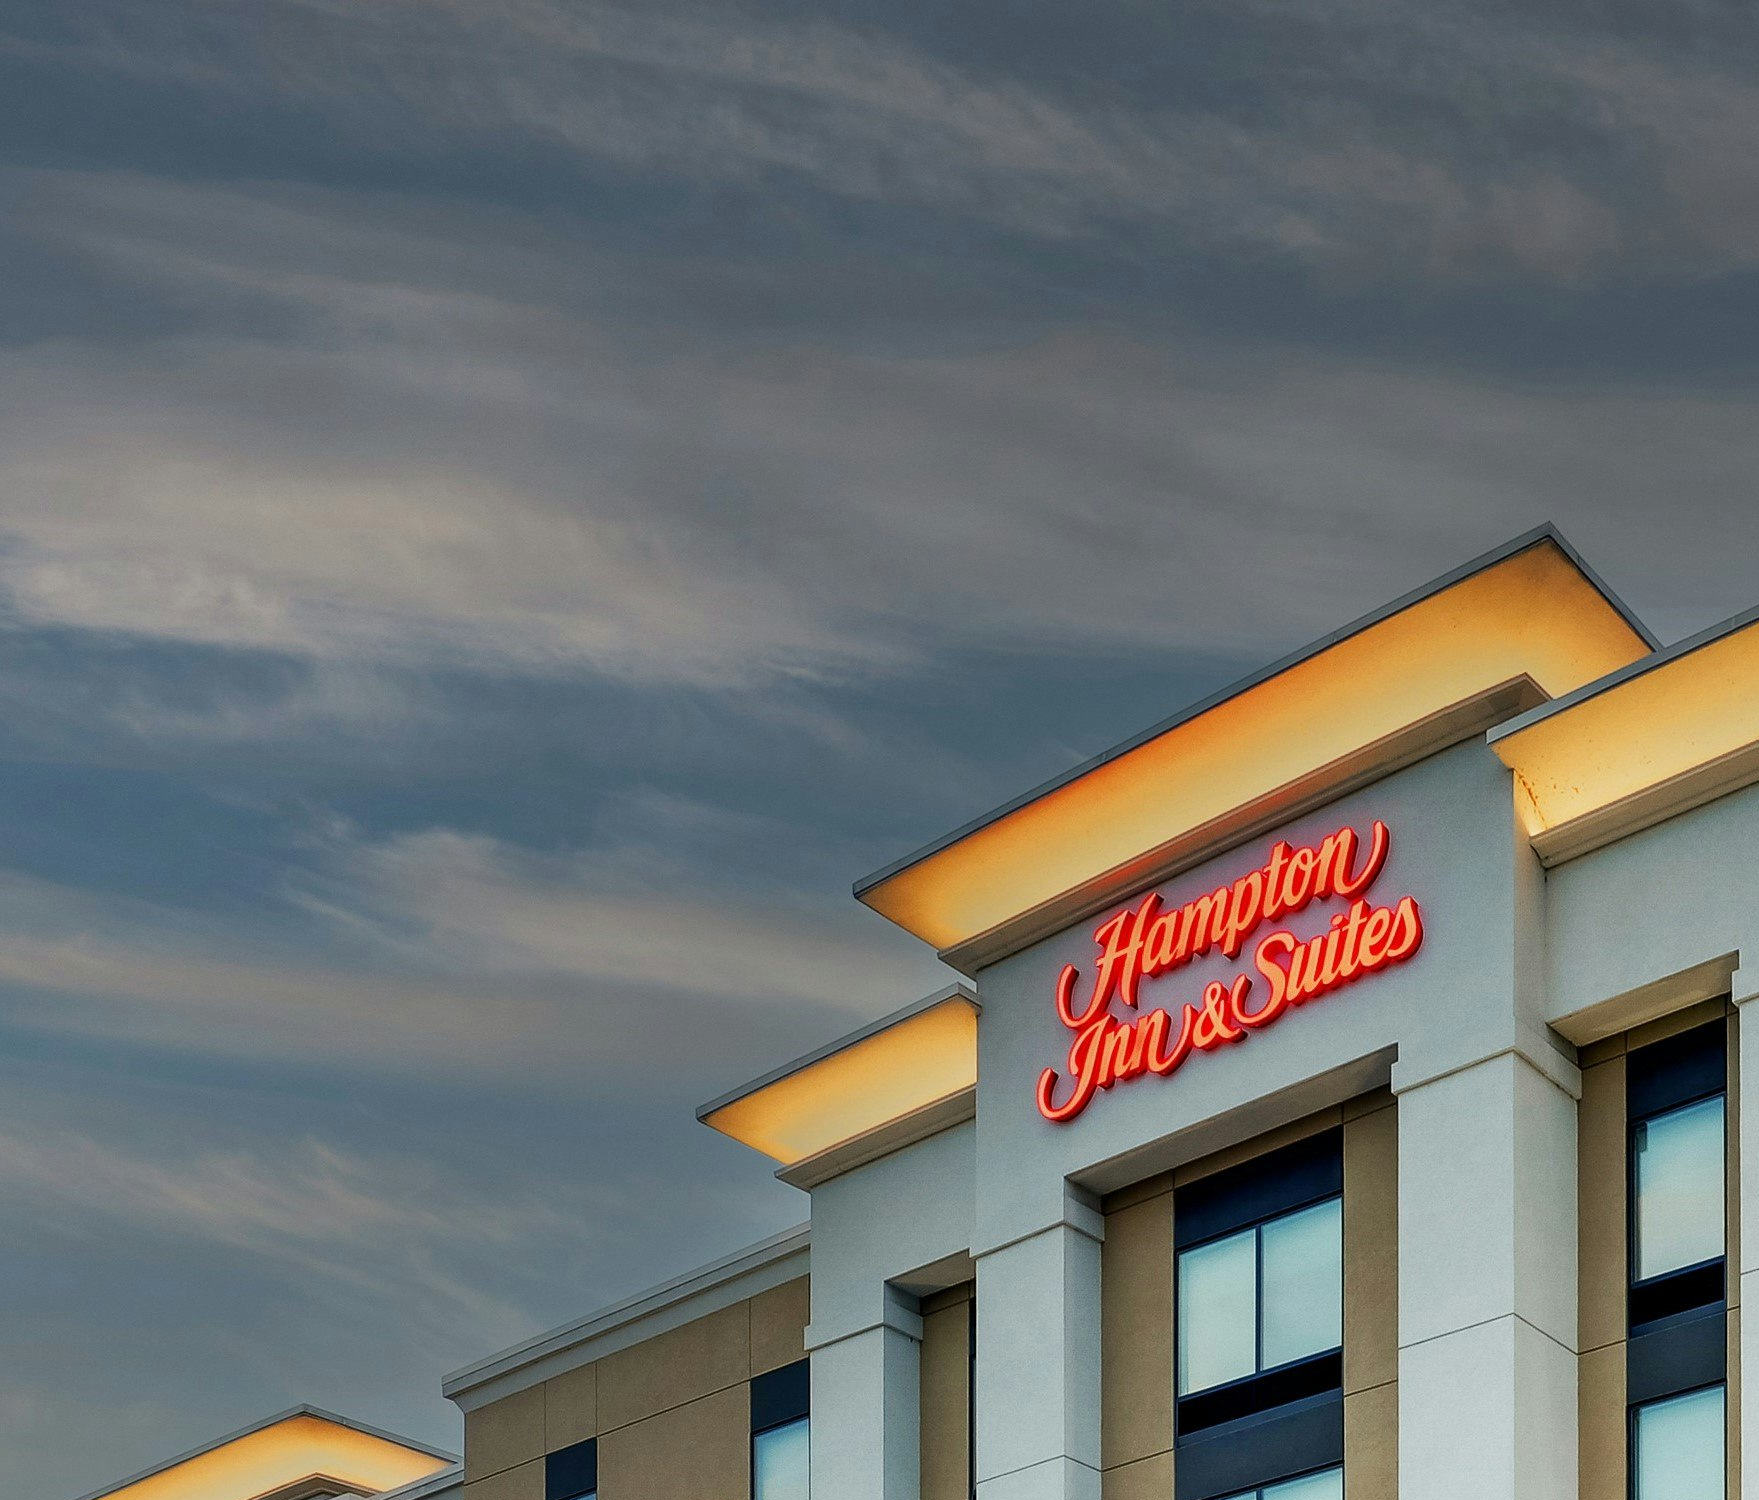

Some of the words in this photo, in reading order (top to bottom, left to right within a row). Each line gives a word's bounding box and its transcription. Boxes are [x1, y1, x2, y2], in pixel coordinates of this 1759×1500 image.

[1036, 1002, 1196, 1123] Inn
[1193, 981, 1248, 1051] &
[1231, 896, 1424, 1029] Suites
[1056, 820, 1391, 1029] Hampton
